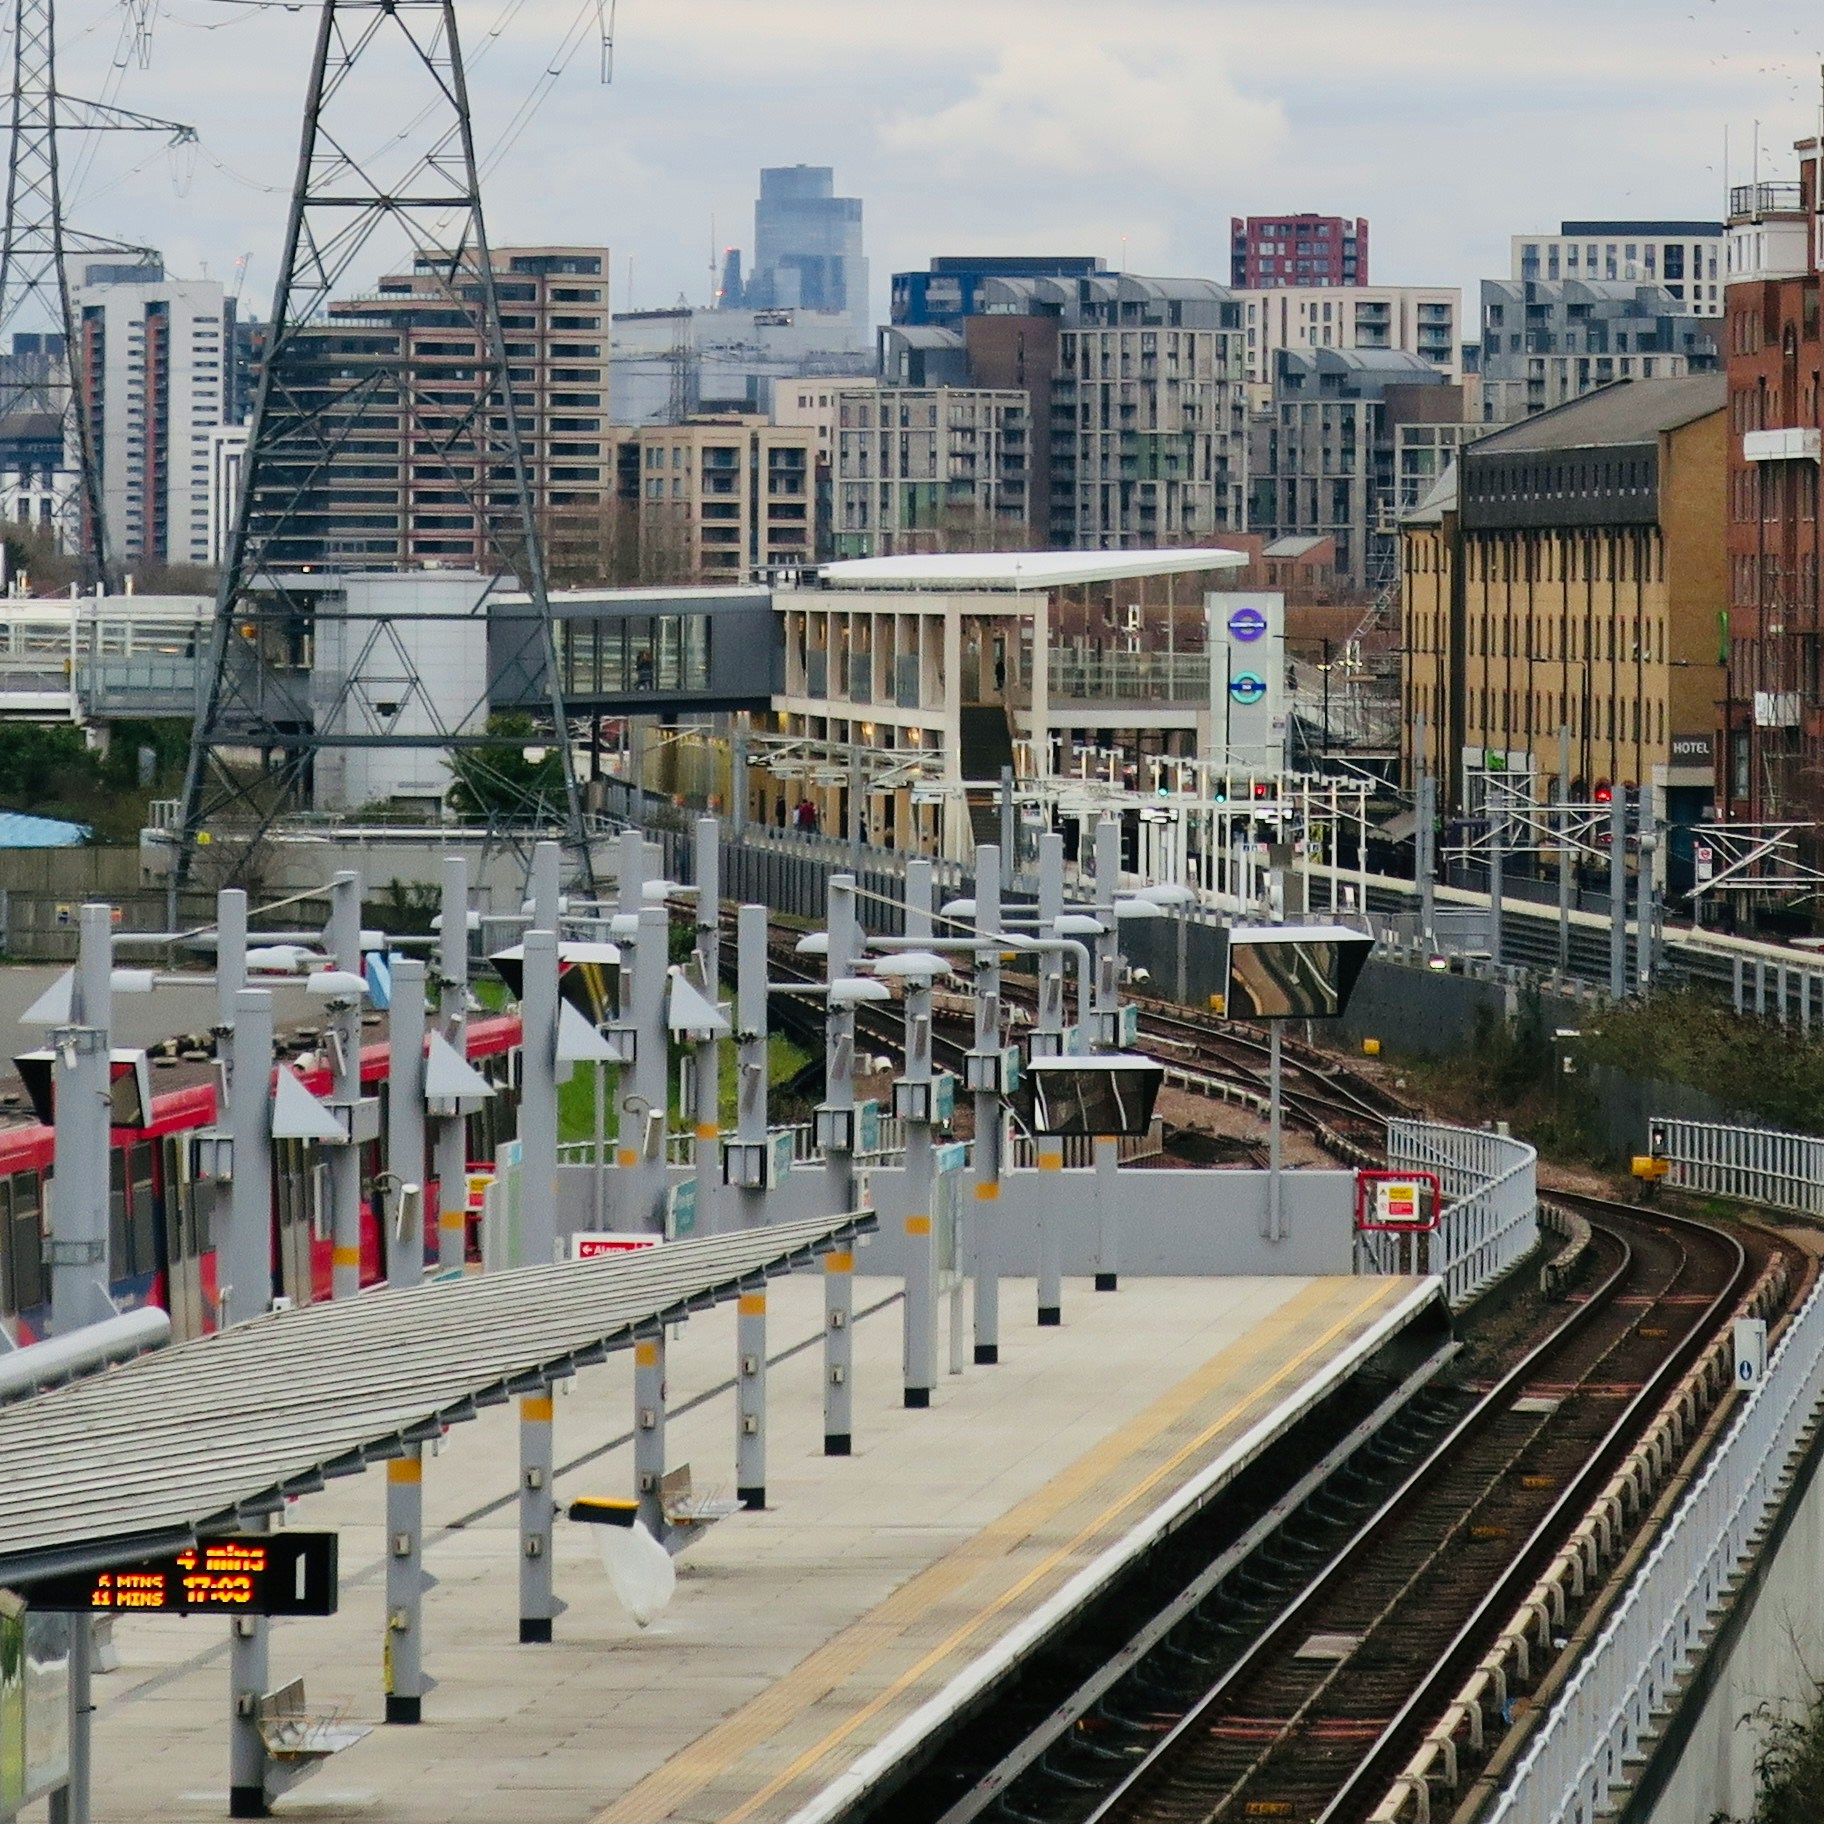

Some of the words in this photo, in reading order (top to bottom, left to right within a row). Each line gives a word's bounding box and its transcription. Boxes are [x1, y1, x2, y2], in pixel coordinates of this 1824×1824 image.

[1673, 742, 1710, 754] HOTEL
[206, 1544, 265, 1571] mins
[91, 1590, 111, 1606] 11
[116, 1590, 164, 1607] MINS
